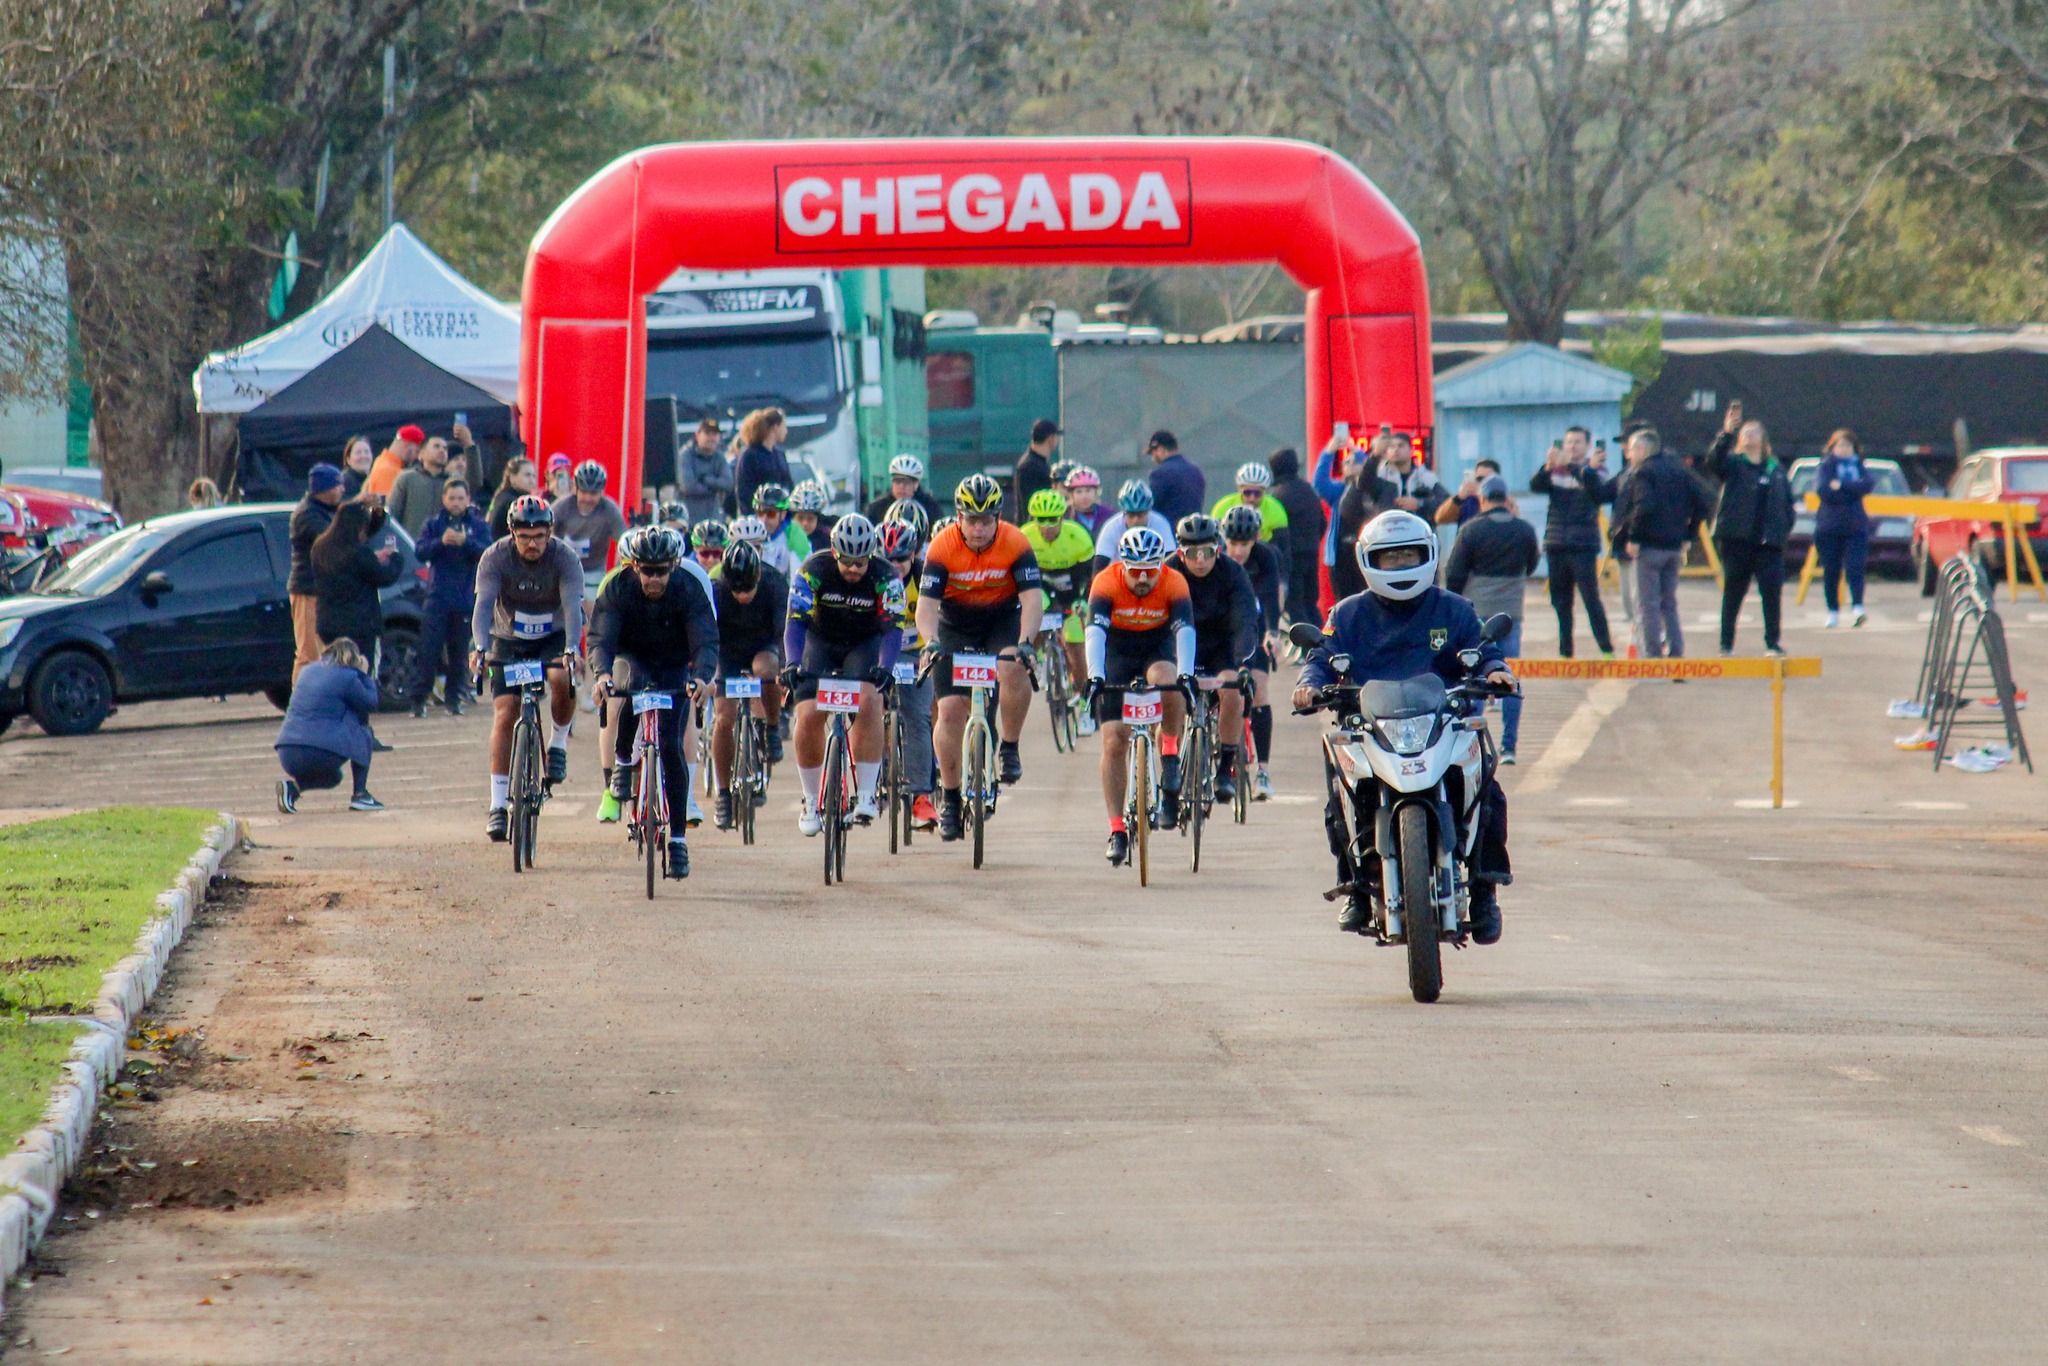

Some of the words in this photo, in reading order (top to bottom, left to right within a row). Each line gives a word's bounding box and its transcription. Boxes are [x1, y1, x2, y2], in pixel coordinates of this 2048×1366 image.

[782, 171, 1182, 237] CHEGADA
[523, 624, 545, 634] 88
[960, 667, 989, 681] 144
[1586, 660, 1723, 679] INTERROMPIDO
[735, 683, 752, 694] 64
[643, 696, 661, 706] 62
[825, 692, 853, 706] 134
[1128, 705, 1157, 718] 139
